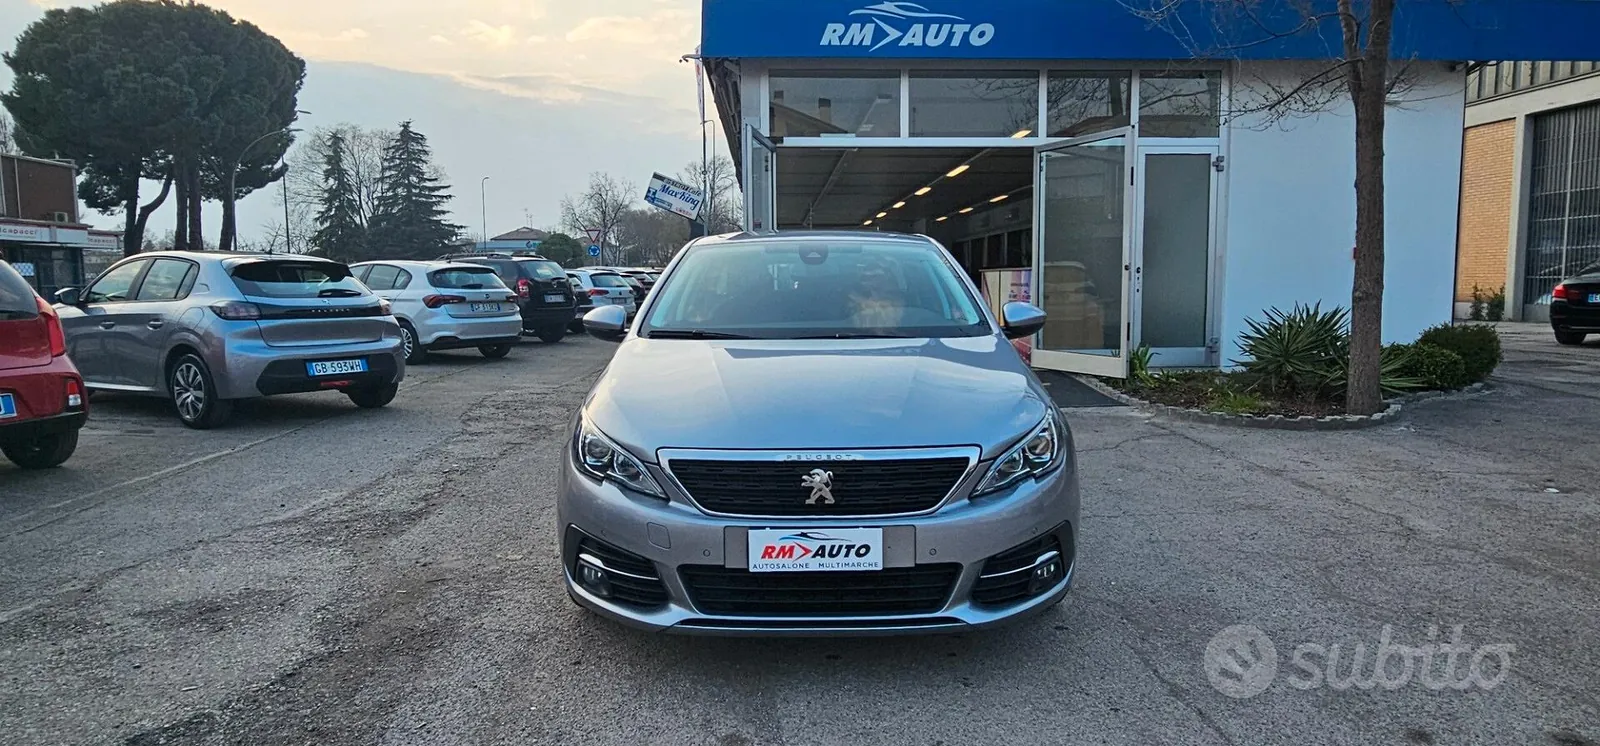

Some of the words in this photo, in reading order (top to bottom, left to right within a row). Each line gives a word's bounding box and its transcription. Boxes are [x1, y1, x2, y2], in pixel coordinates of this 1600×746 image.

[898, 22, 995, 47] AUTO
[314, 363, 328, 374] GB
[330, 359, 363, 373] 593WH
[811, 543, 872, 559] AUTO
[752, 562, 810, 570] AUTOSALONE
[818, 561, 879, 569] MULTIMARCHE
